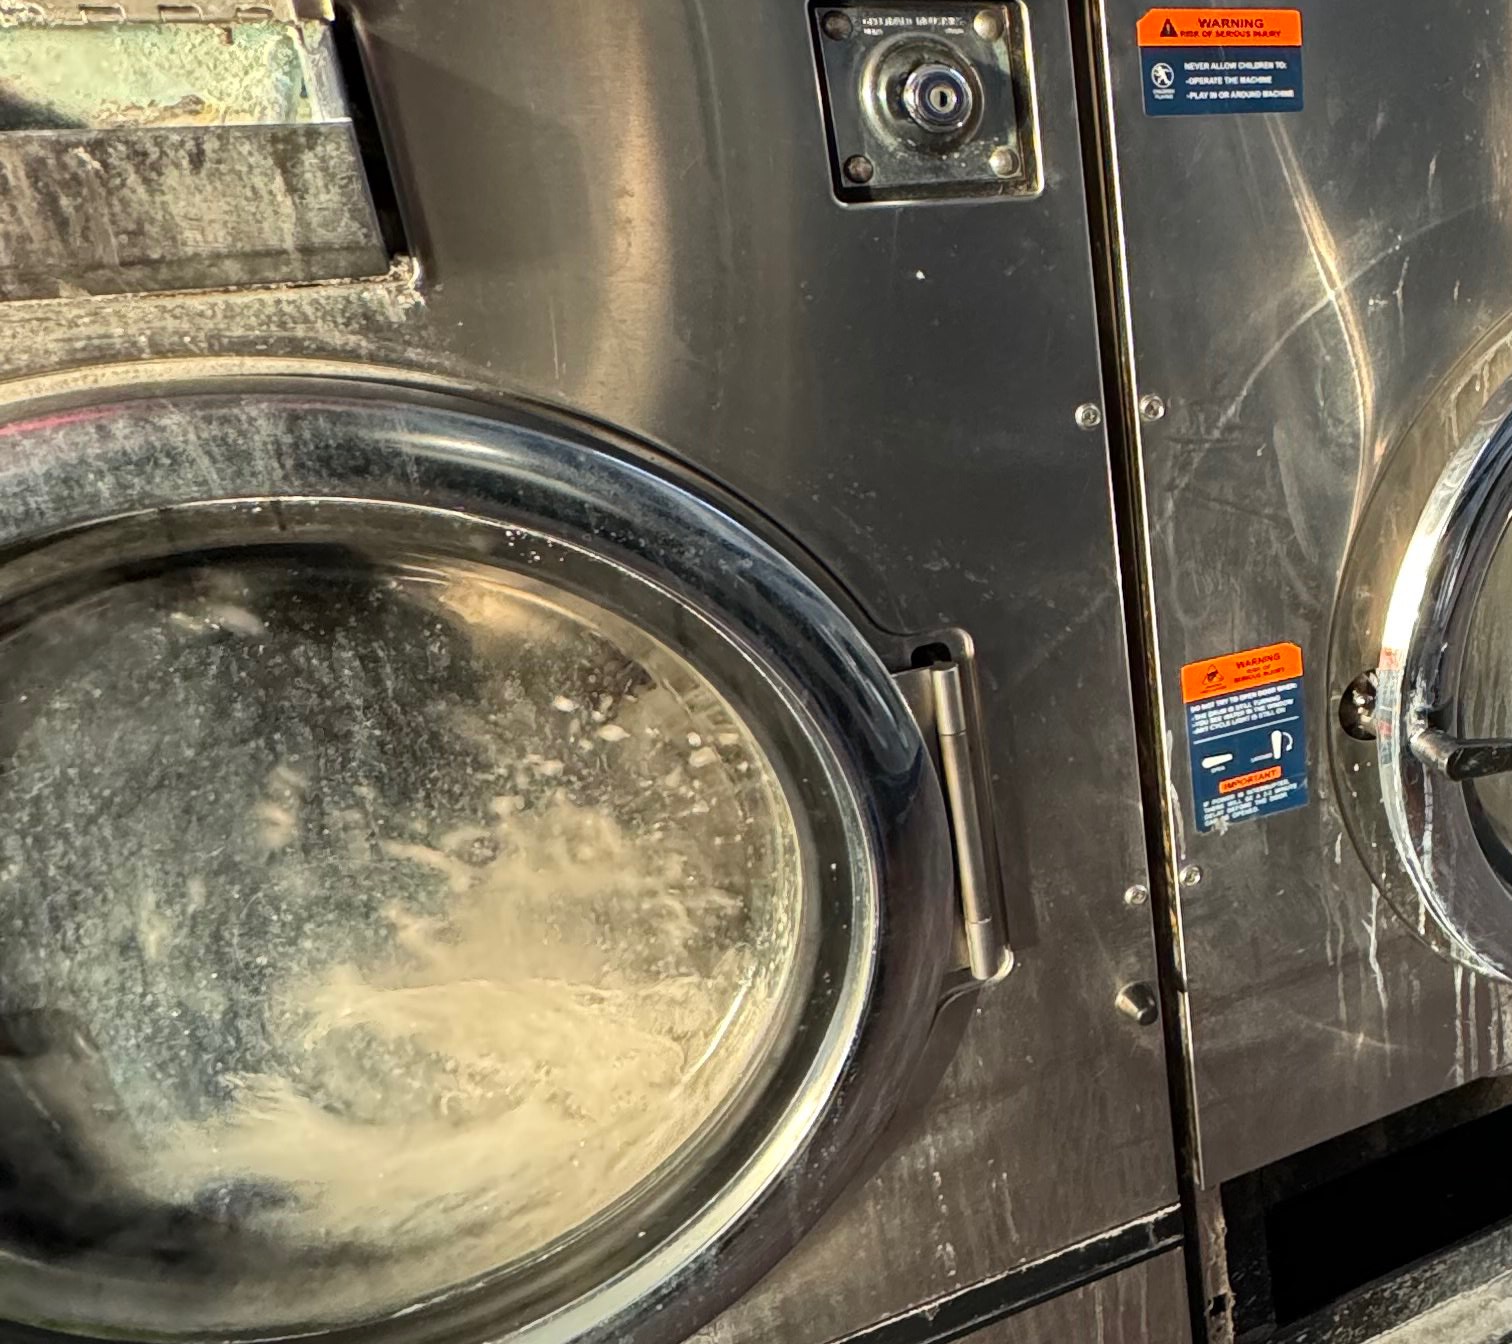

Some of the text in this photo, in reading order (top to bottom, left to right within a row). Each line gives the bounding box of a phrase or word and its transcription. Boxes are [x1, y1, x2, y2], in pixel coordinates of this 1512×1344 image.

[1198, 18, 1264, 29] WARNING
[1184, 62, 1210, 71] NEVER
[1211, 62, 1236, 70] ALLOW
[1236, 653, 1281, 669] WARNING
[1224, 769, 1277, 789] IMPORTANT
